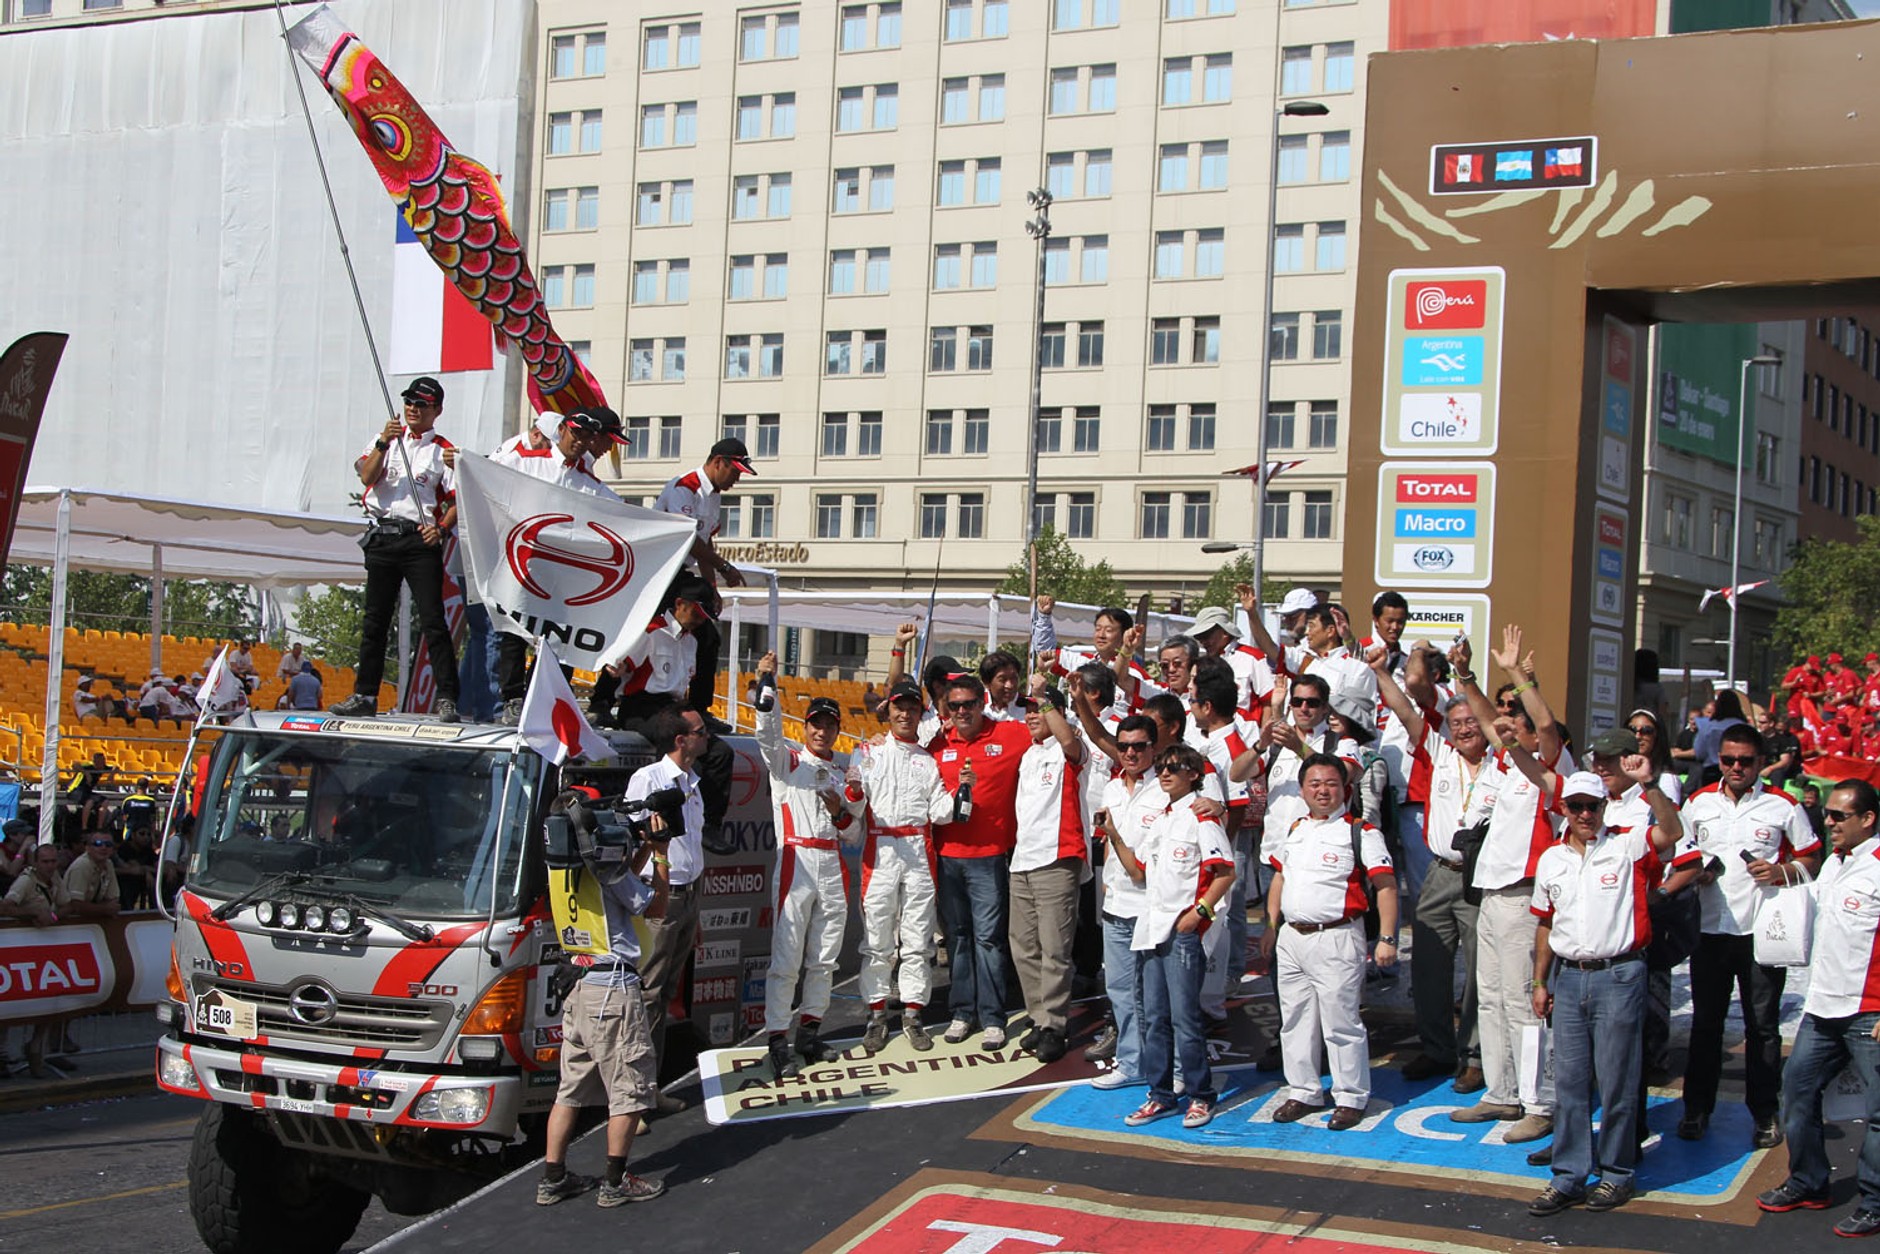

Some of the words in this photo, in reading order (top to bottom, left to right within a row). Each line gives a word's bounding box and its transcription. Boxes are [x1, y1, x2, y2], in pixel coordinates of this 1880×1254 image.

[1416, 287, 1474, 324] Perú
[1421, 340, 1463, 352] Argentina
[1411, 420, 1457, 437] Chile
[1402, 480, 1471, 496] TOTAL
[1404, 514, 1466, 532] Macro
[714, 541, 810, 564] ancoEstado
[1422, 550, 1445, 561] FOX
[567, 894, 579, 923] 9
[715, 948, 736, 960] LINE
[193, 956, 243, 975] HINO
[408, 983, 458, 996] 500
[213, 1008, 232, 1025] 508
[740, 1082, 890, 1110] CHILE
